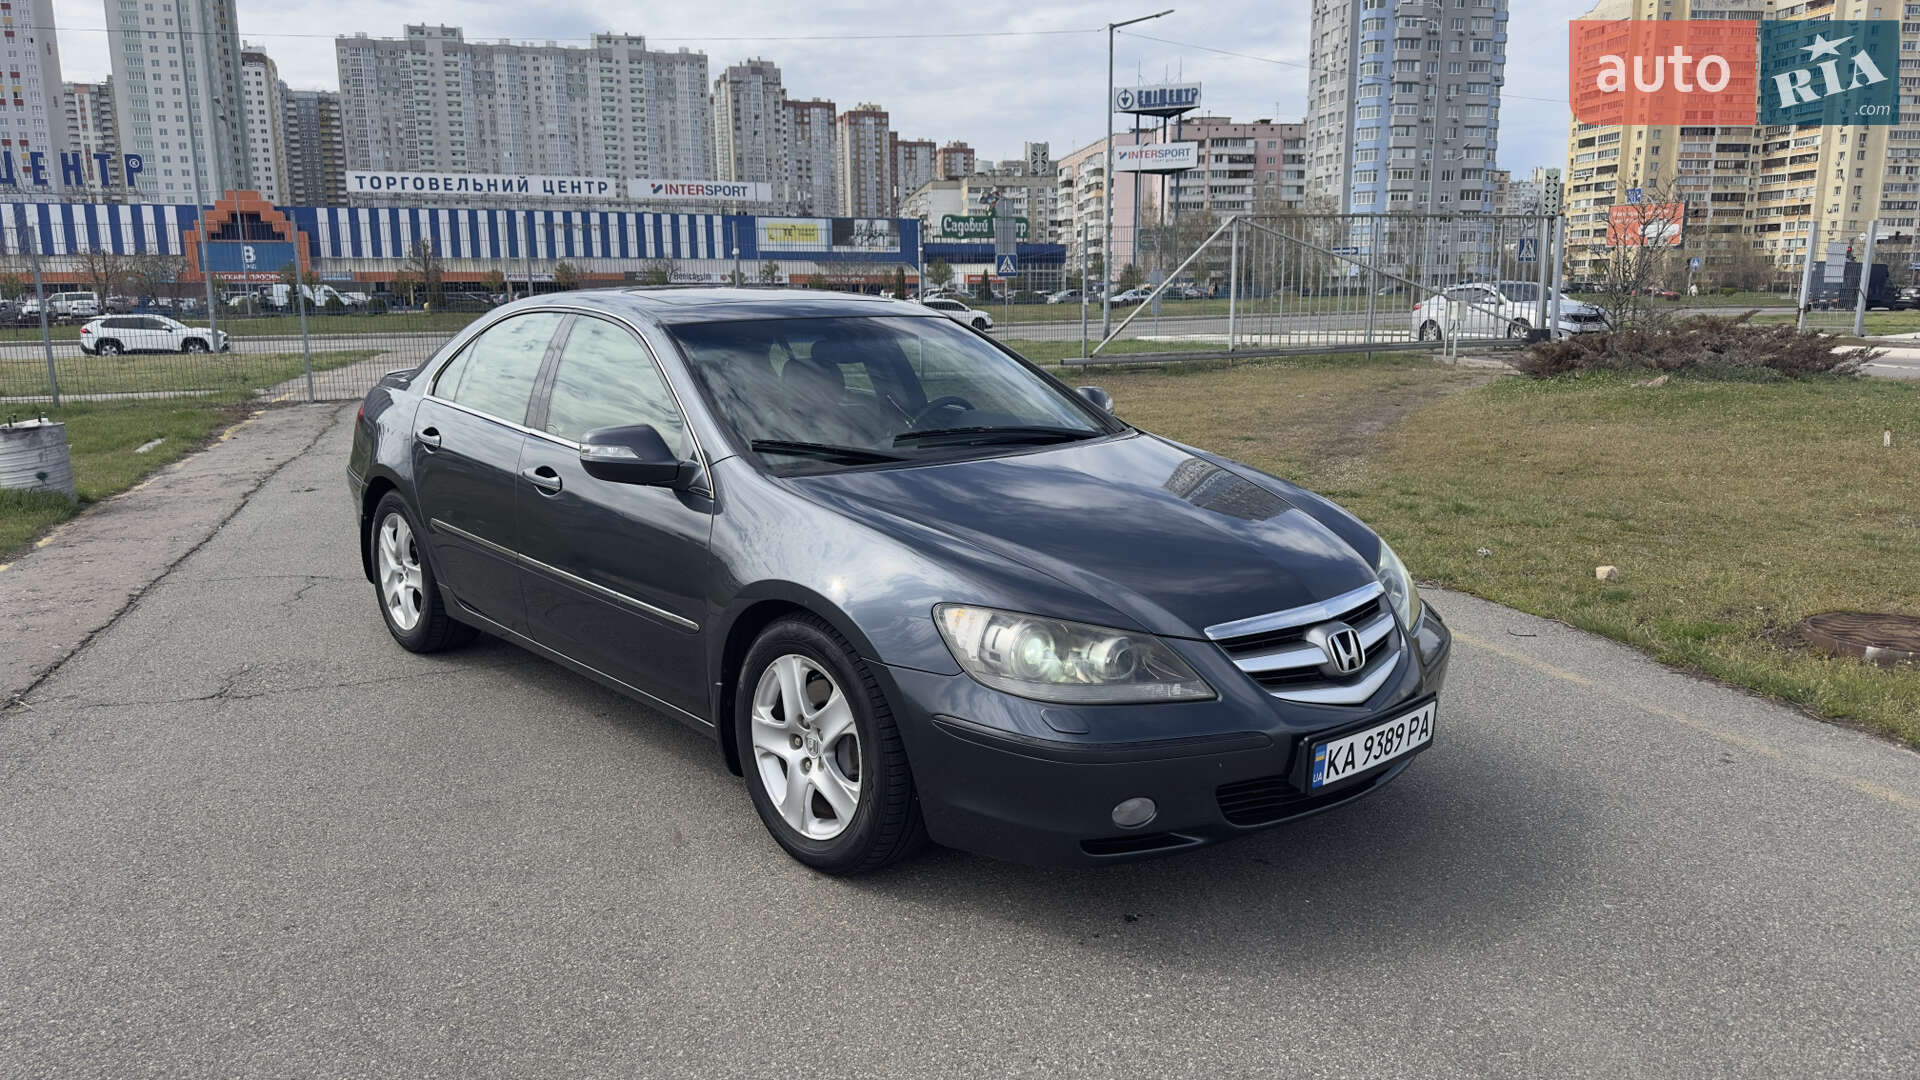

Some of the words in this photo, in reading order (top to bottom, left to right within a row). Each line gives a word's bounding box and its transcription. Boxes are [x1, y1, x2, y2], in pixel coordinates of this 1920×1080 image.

[1128, 147, 1191, 160] INTERSPORT
[355, 175, 529, 192] ТОРГОВЕЛЬНИЙ
[542, 179, 609, 195] ЦЕНТР
[664, 183, 748, 197] INTERSPORT
[1326, 742, 1355, 779] KA
[1362, 723, 1405, 766] 9389
[1407, 710, 1429, 747] PA
[1313, 772, 1323, 783] UA
